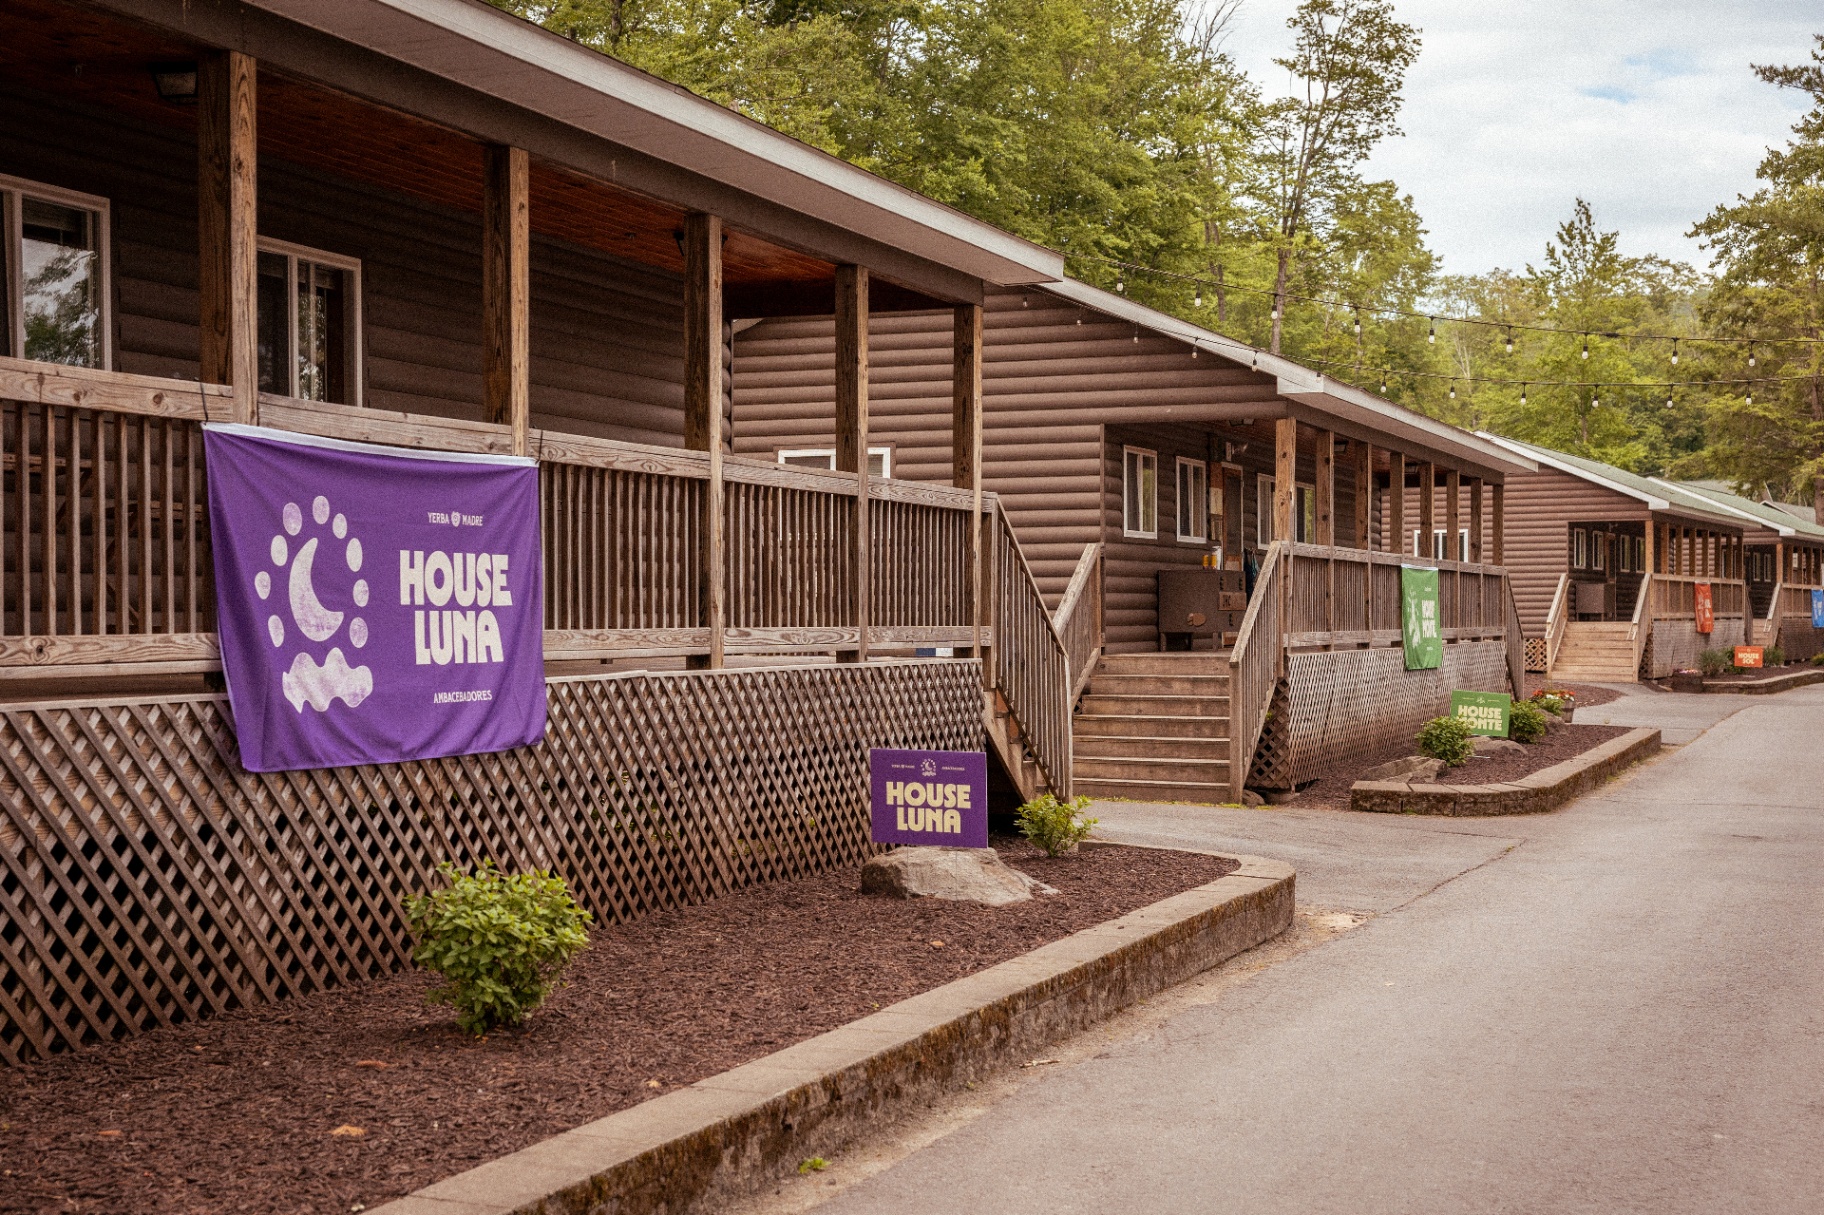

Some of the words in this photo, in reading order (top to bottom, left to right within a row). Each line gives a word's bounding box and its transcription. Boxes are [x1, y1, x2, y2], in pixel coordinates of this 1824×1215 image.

[427, 512, 450, 524] YERBA
[462, 514, 484, 526] MADRE
[400, 549, 513, 607] HOUSE
[414, 609, 505, 666] LUNA
[1457, 704, 1502, 719] HOUSE
[886, 781, 971, 808] HOUSE
[897, 807, 961, 833] LUNA
